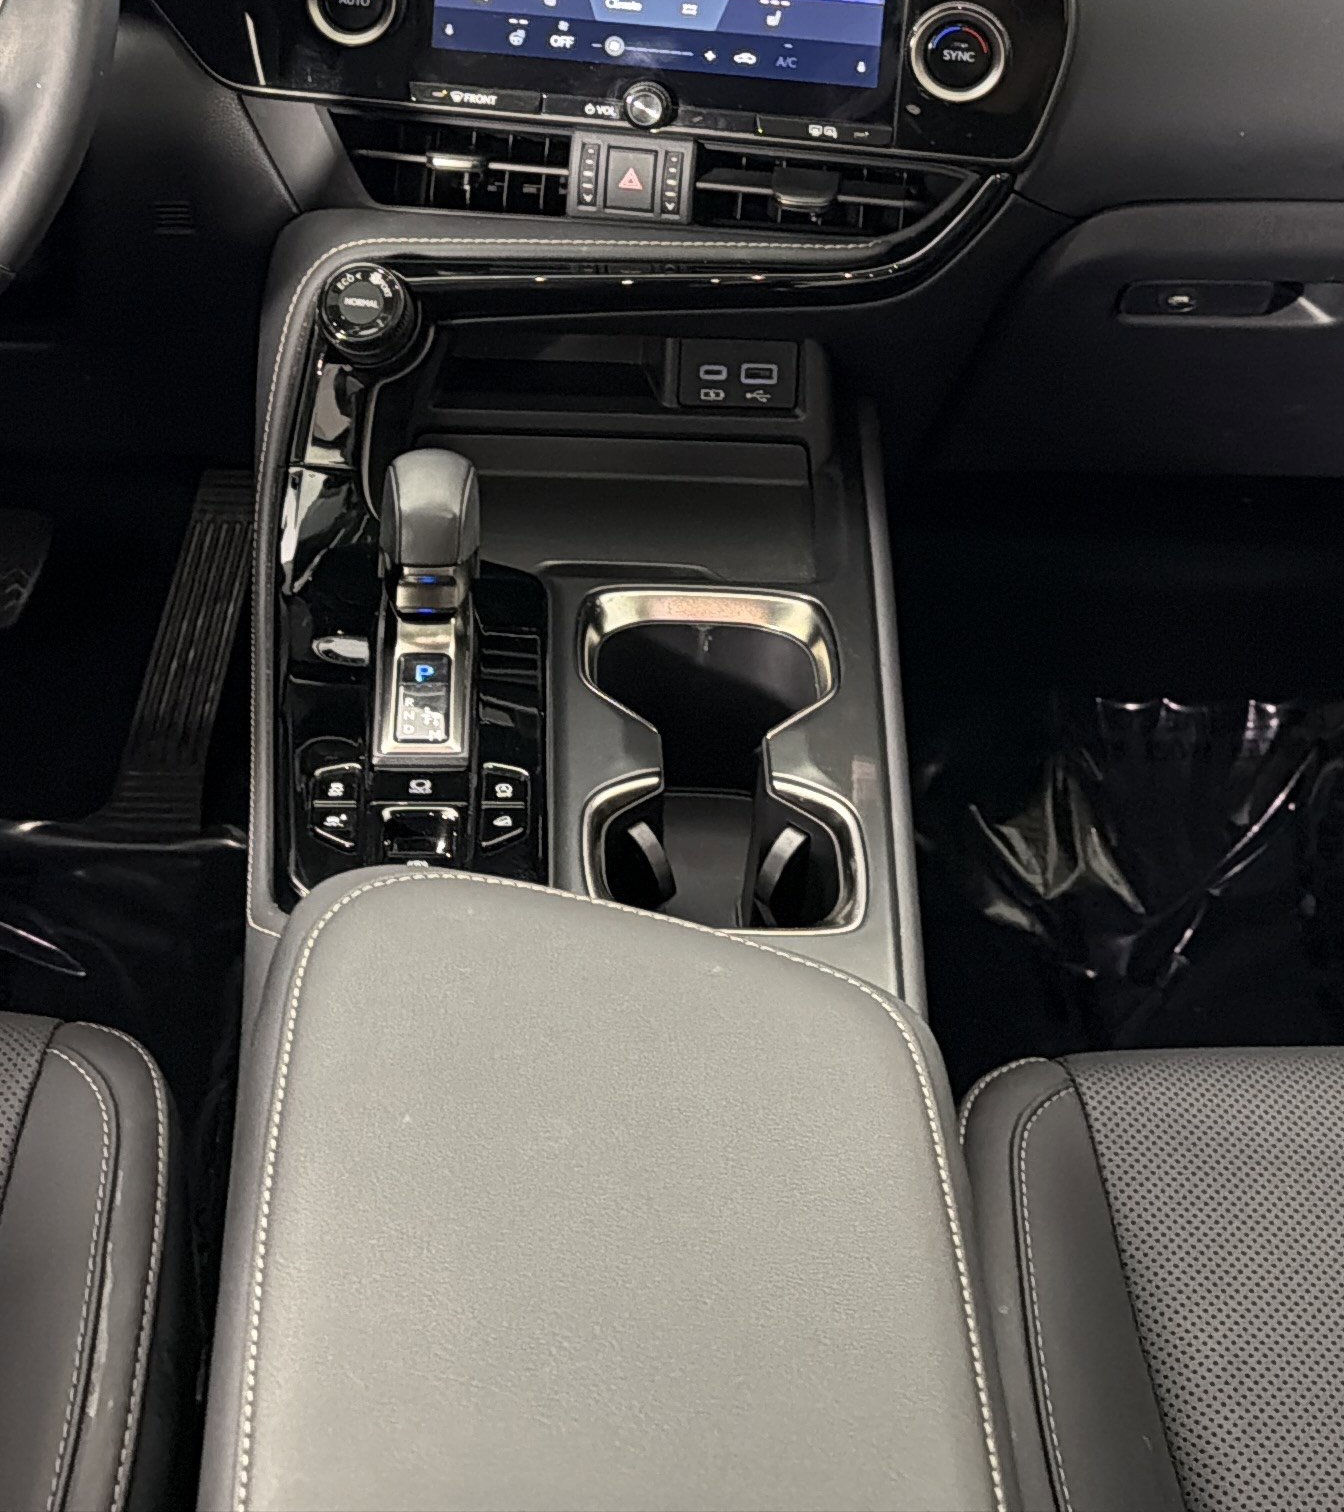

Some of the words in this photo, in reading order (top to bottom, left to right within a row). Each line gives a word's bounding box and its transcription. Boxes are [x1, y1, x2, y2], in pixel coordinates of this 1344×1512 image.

[549, 34, 575, 48] OFF
[776, 56, 798, 69] A/C
[942, 49, 976, 63] SYNC
[463, 93, 498, 106] FRONT
[596, 104, 617, 118] VOL
[336, 272, 355, 290] ECO
[343, 297, 379, 309] NORMAL
[414, 664, 435, 683] P
[404, 697, 415, 708] R
[403, 710, 415, 721] N
[402, 724, 415, 735] D
